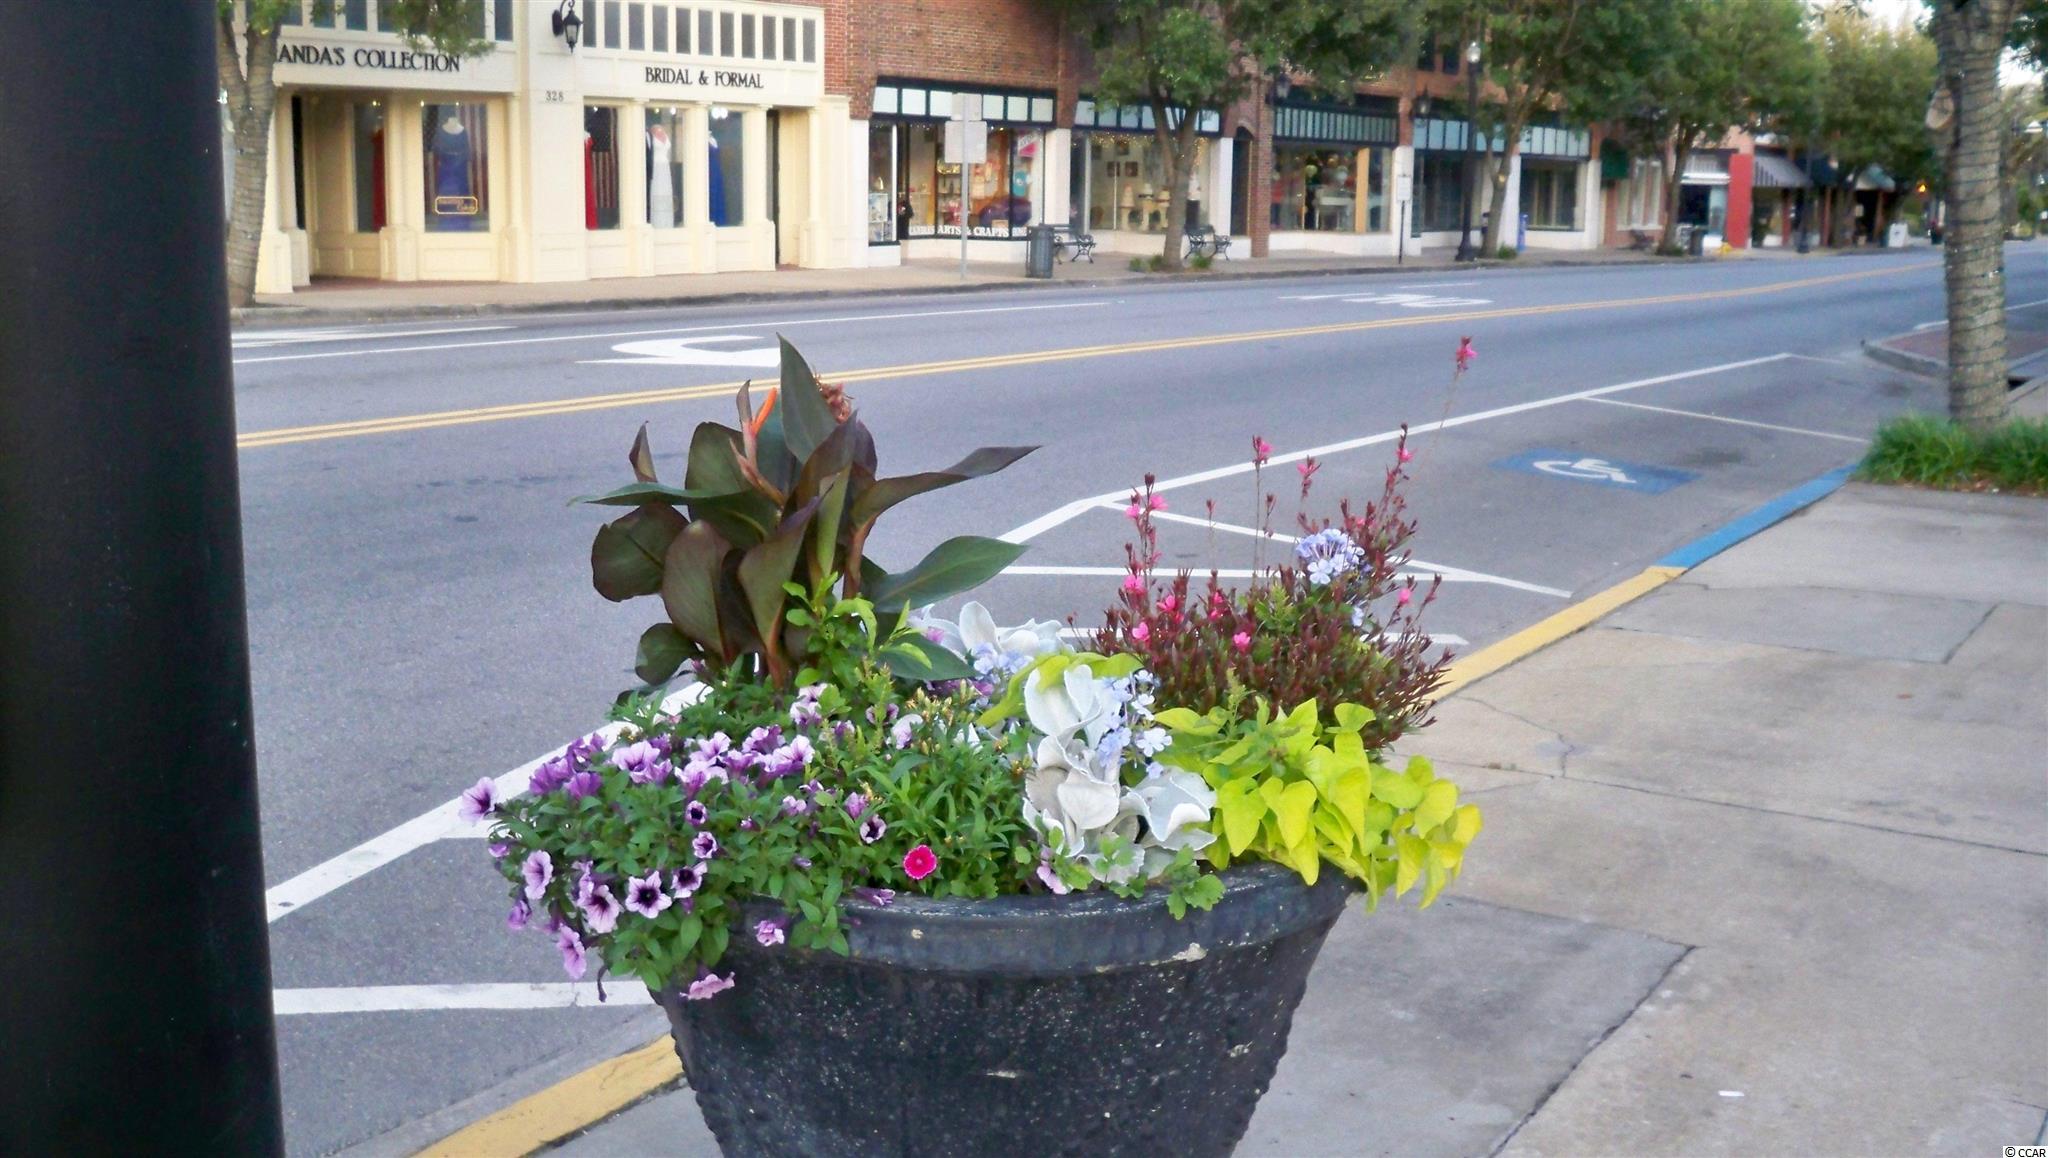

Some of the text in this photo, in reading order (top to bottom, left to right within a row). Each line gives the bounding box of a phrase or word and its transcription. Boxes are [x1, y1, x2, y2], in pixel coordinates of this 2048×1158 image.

[277, 43, 461, 72] ANDA'S COLLECTION
[645, 66, 764, 89] BRIDAL & FORMAL
[545, 90, 564, 102] 328
[937, 225, 961, 235] ARTS
[973, 226, 1010, 237] CRAFTS
